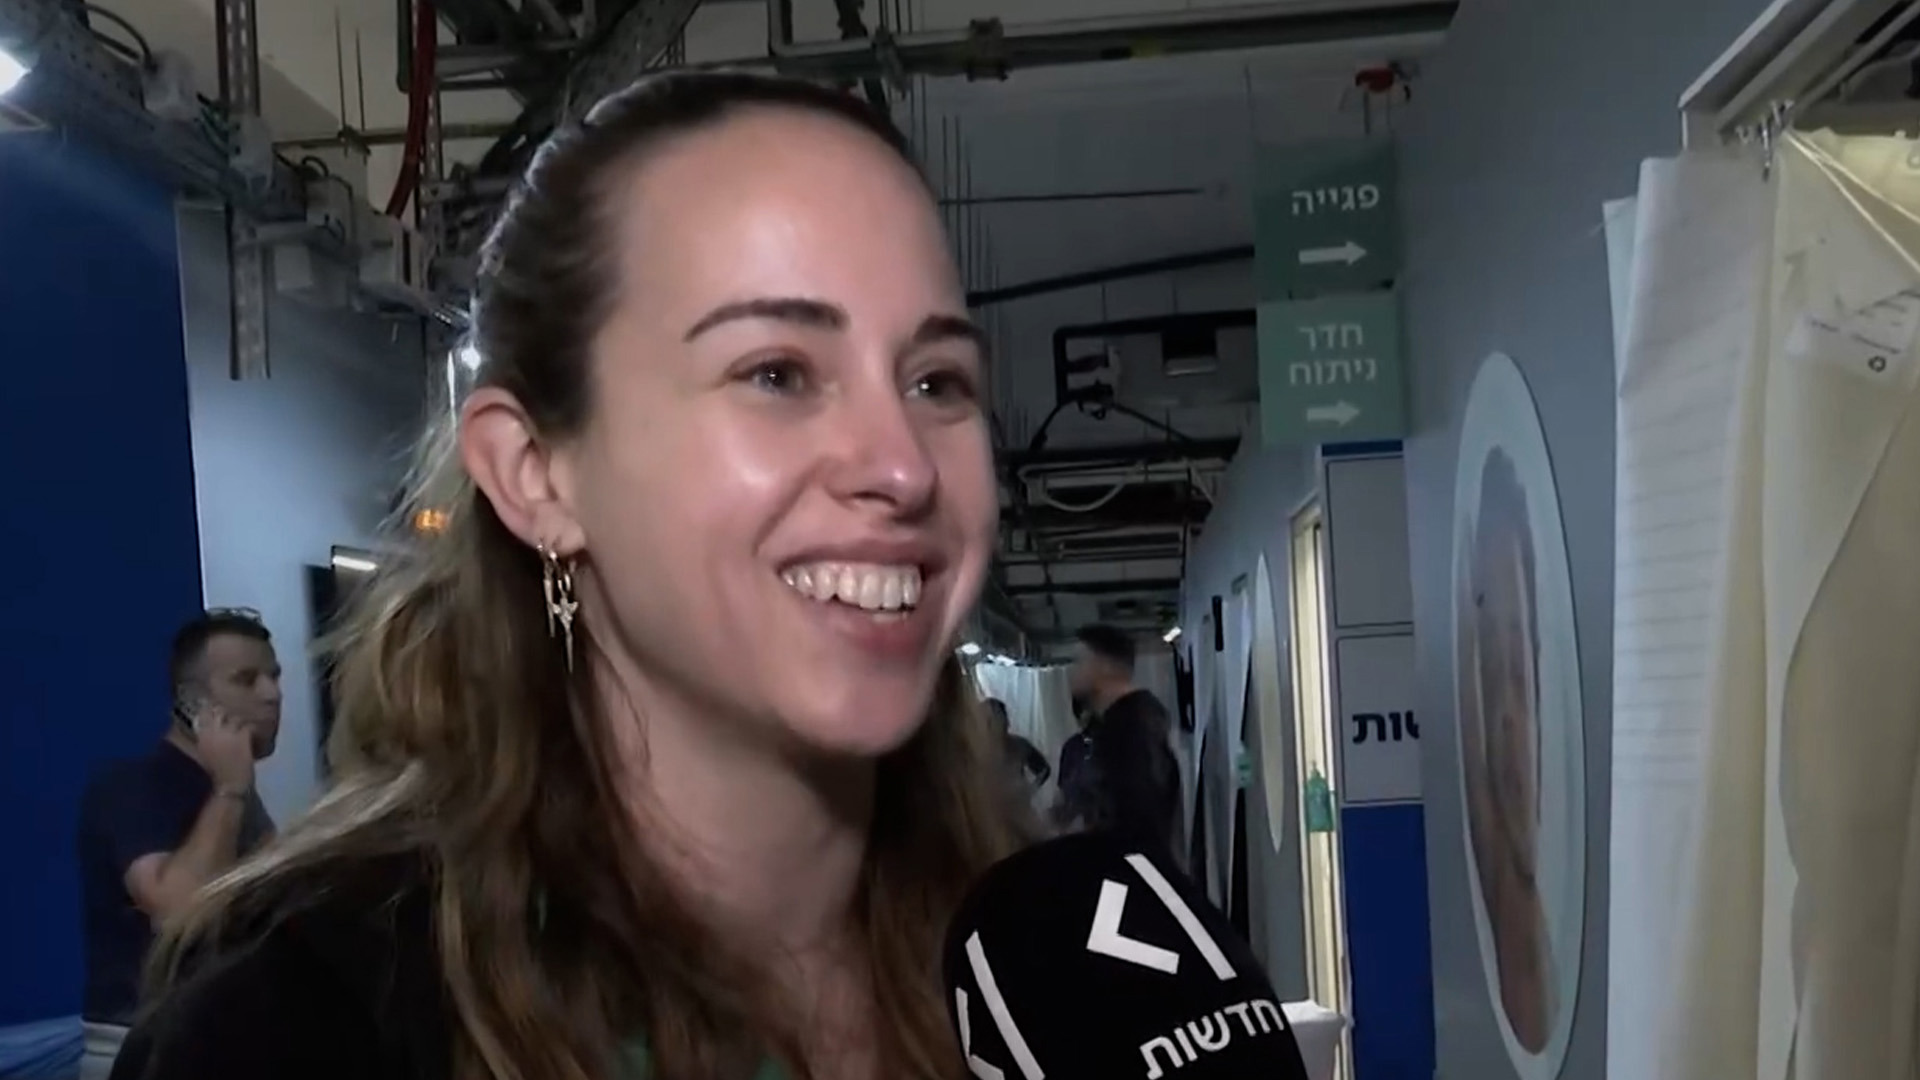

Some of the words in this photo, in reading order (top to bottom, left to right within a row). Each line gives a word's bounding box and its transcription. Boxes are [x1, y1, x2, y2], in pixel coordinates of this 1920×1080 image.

[1291, 184, 1379, 215] פגייה
[1298, 323, 1363, 350] חדר
[1289, 358, 1377, 386] ניתוח
[1140, 999, 1285, 1080] חדשות
